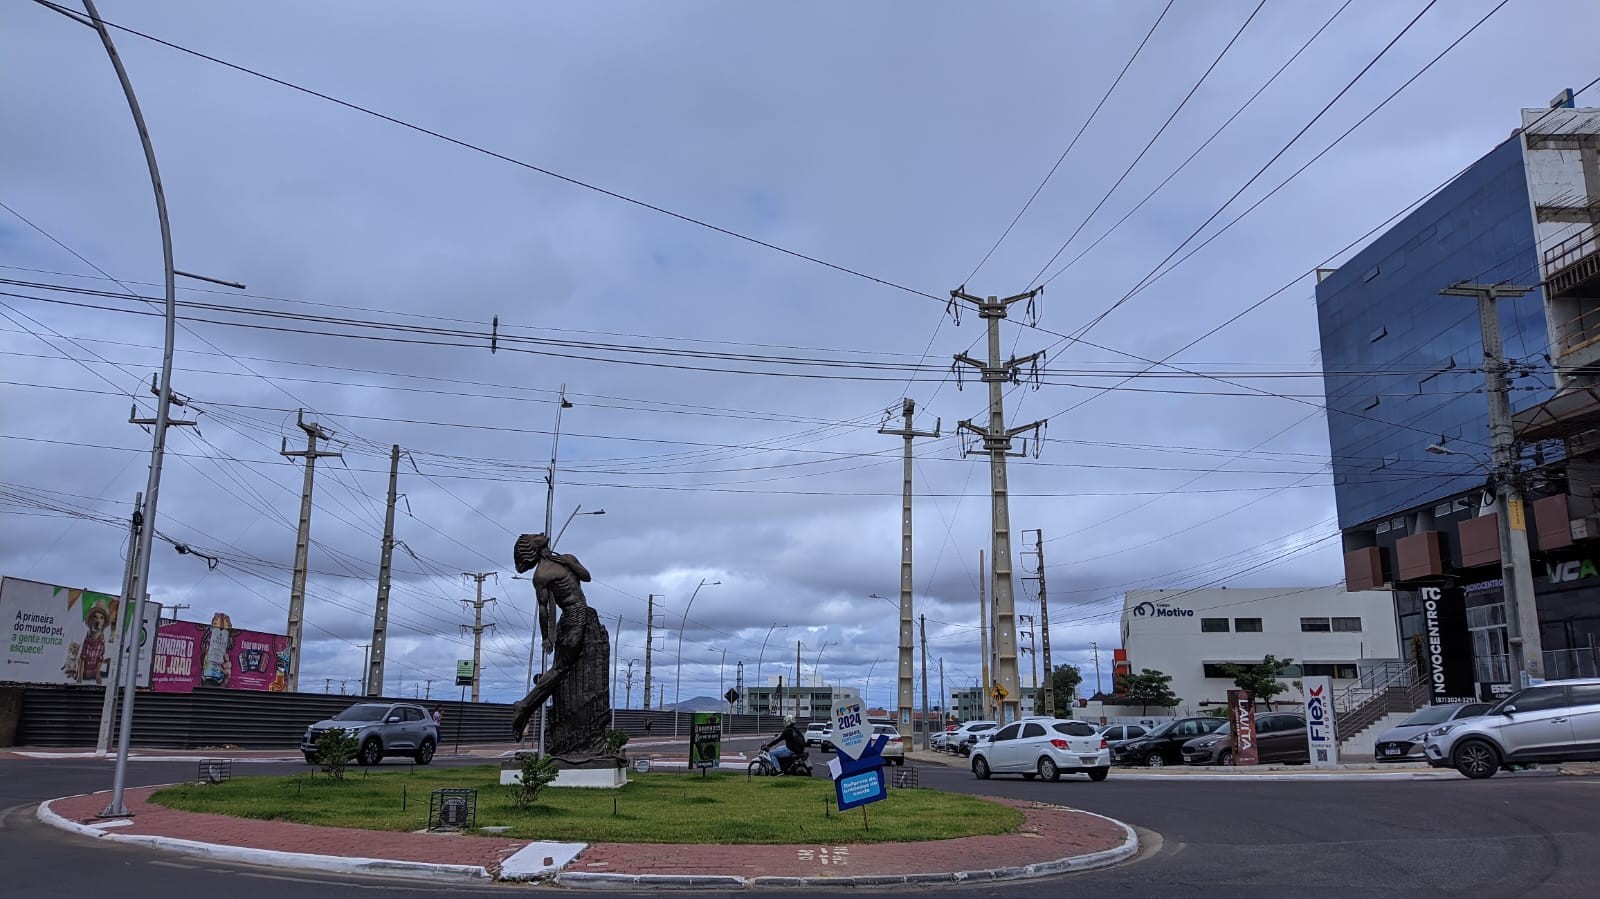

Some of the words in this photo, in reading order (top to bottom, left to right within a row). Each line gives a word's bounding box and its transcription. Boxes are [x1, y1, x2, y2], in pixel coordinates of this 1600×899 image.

[1546, 560, 1598, 584] VCA
[16, 610, 21, 620] A
[23, 612, 54, 624] primeira
[1157, 608, 1194, 617] Motivo
[14, 621, 24, 631] do
[25, 623, 51, 634] mundo
[51, 626, 65, 638] pet,
[11, 633, 17, 642] a
[18, 633, 40, 645] gente
[41, 636, 63, 646] nunca
[1425, 600, 1446, 693] NOVOCENTRO
[10, 644, 44, 655] esquece!
[1491, 684, 1513, 693] ESTAC
[1308, 684, 1326, 741] Flex
[838, 713, 862, 730] 2024
